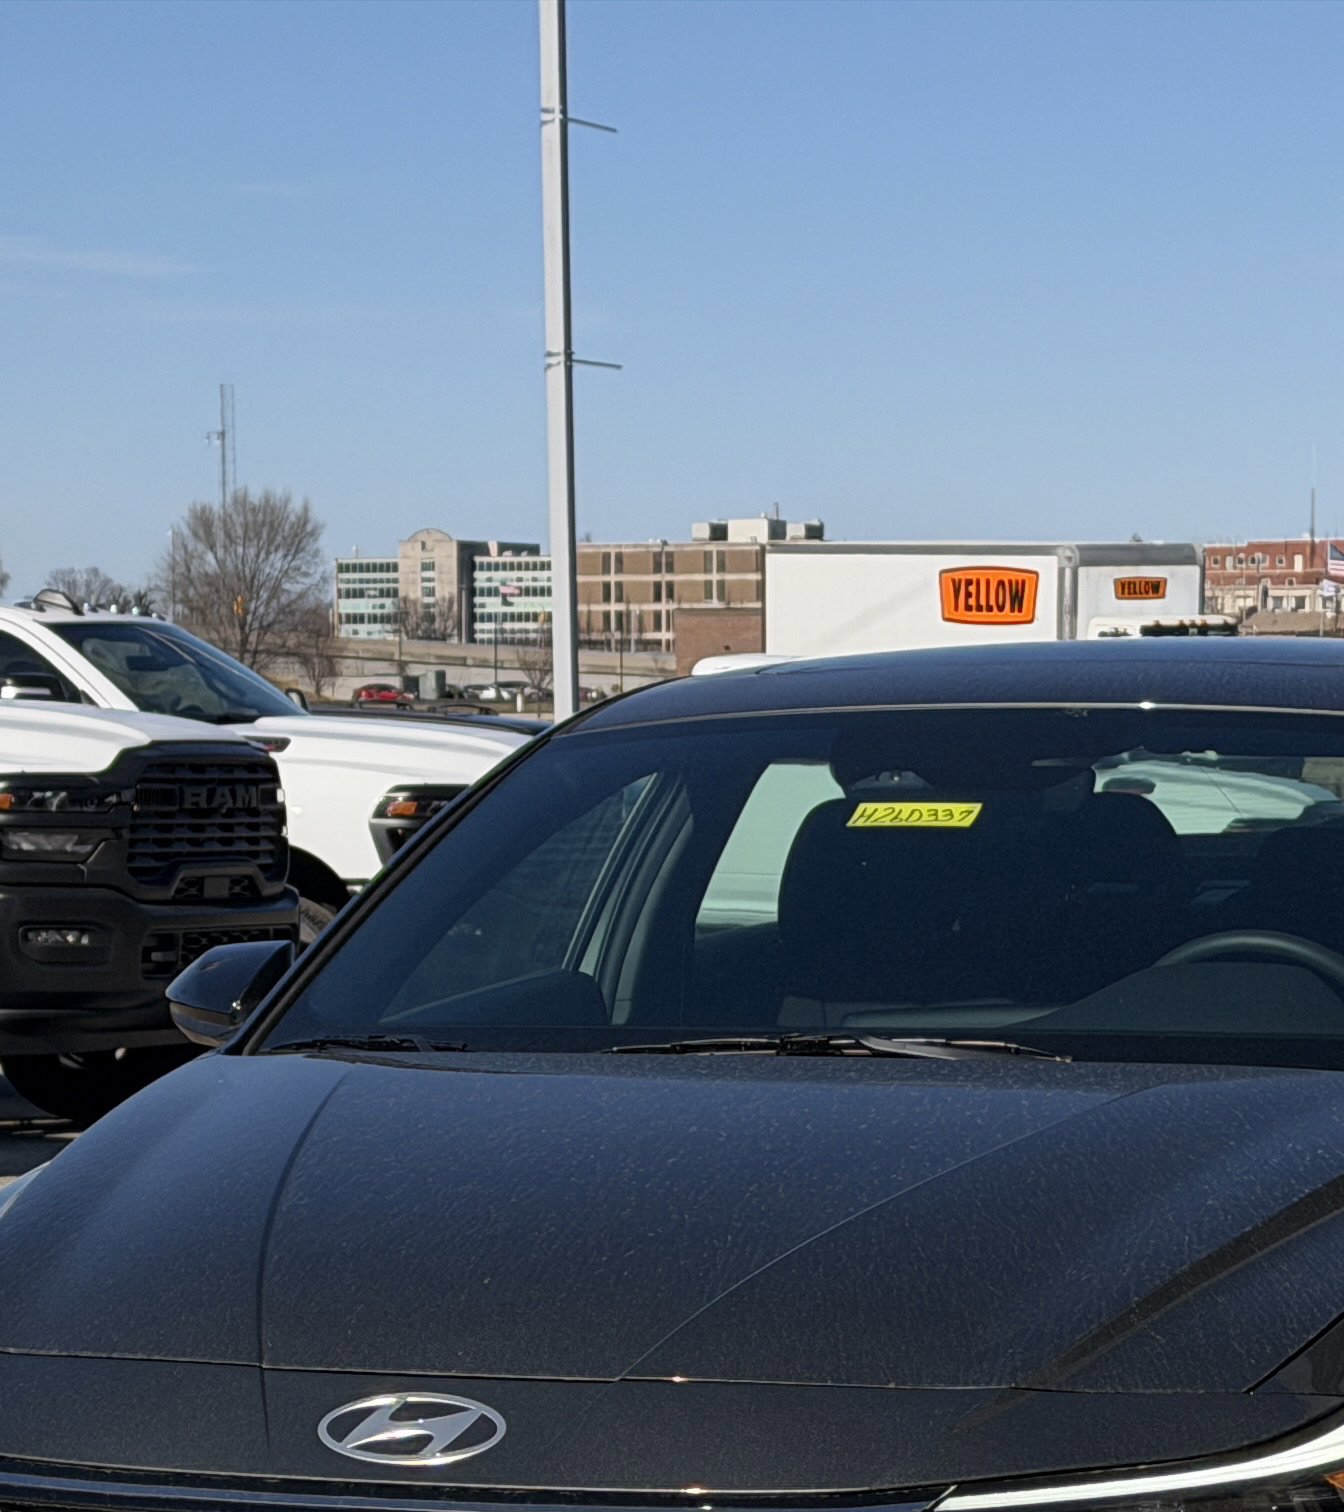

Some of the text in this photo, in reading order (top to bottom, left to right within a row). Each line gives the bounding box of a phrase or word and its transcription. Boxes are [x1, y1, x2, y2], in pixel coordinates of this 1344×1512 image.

[951, 577, 1026, 614] YELLOW
[1120, 580, 1161, 596] YELLOW
[182, 784, 257, 809] RAM
